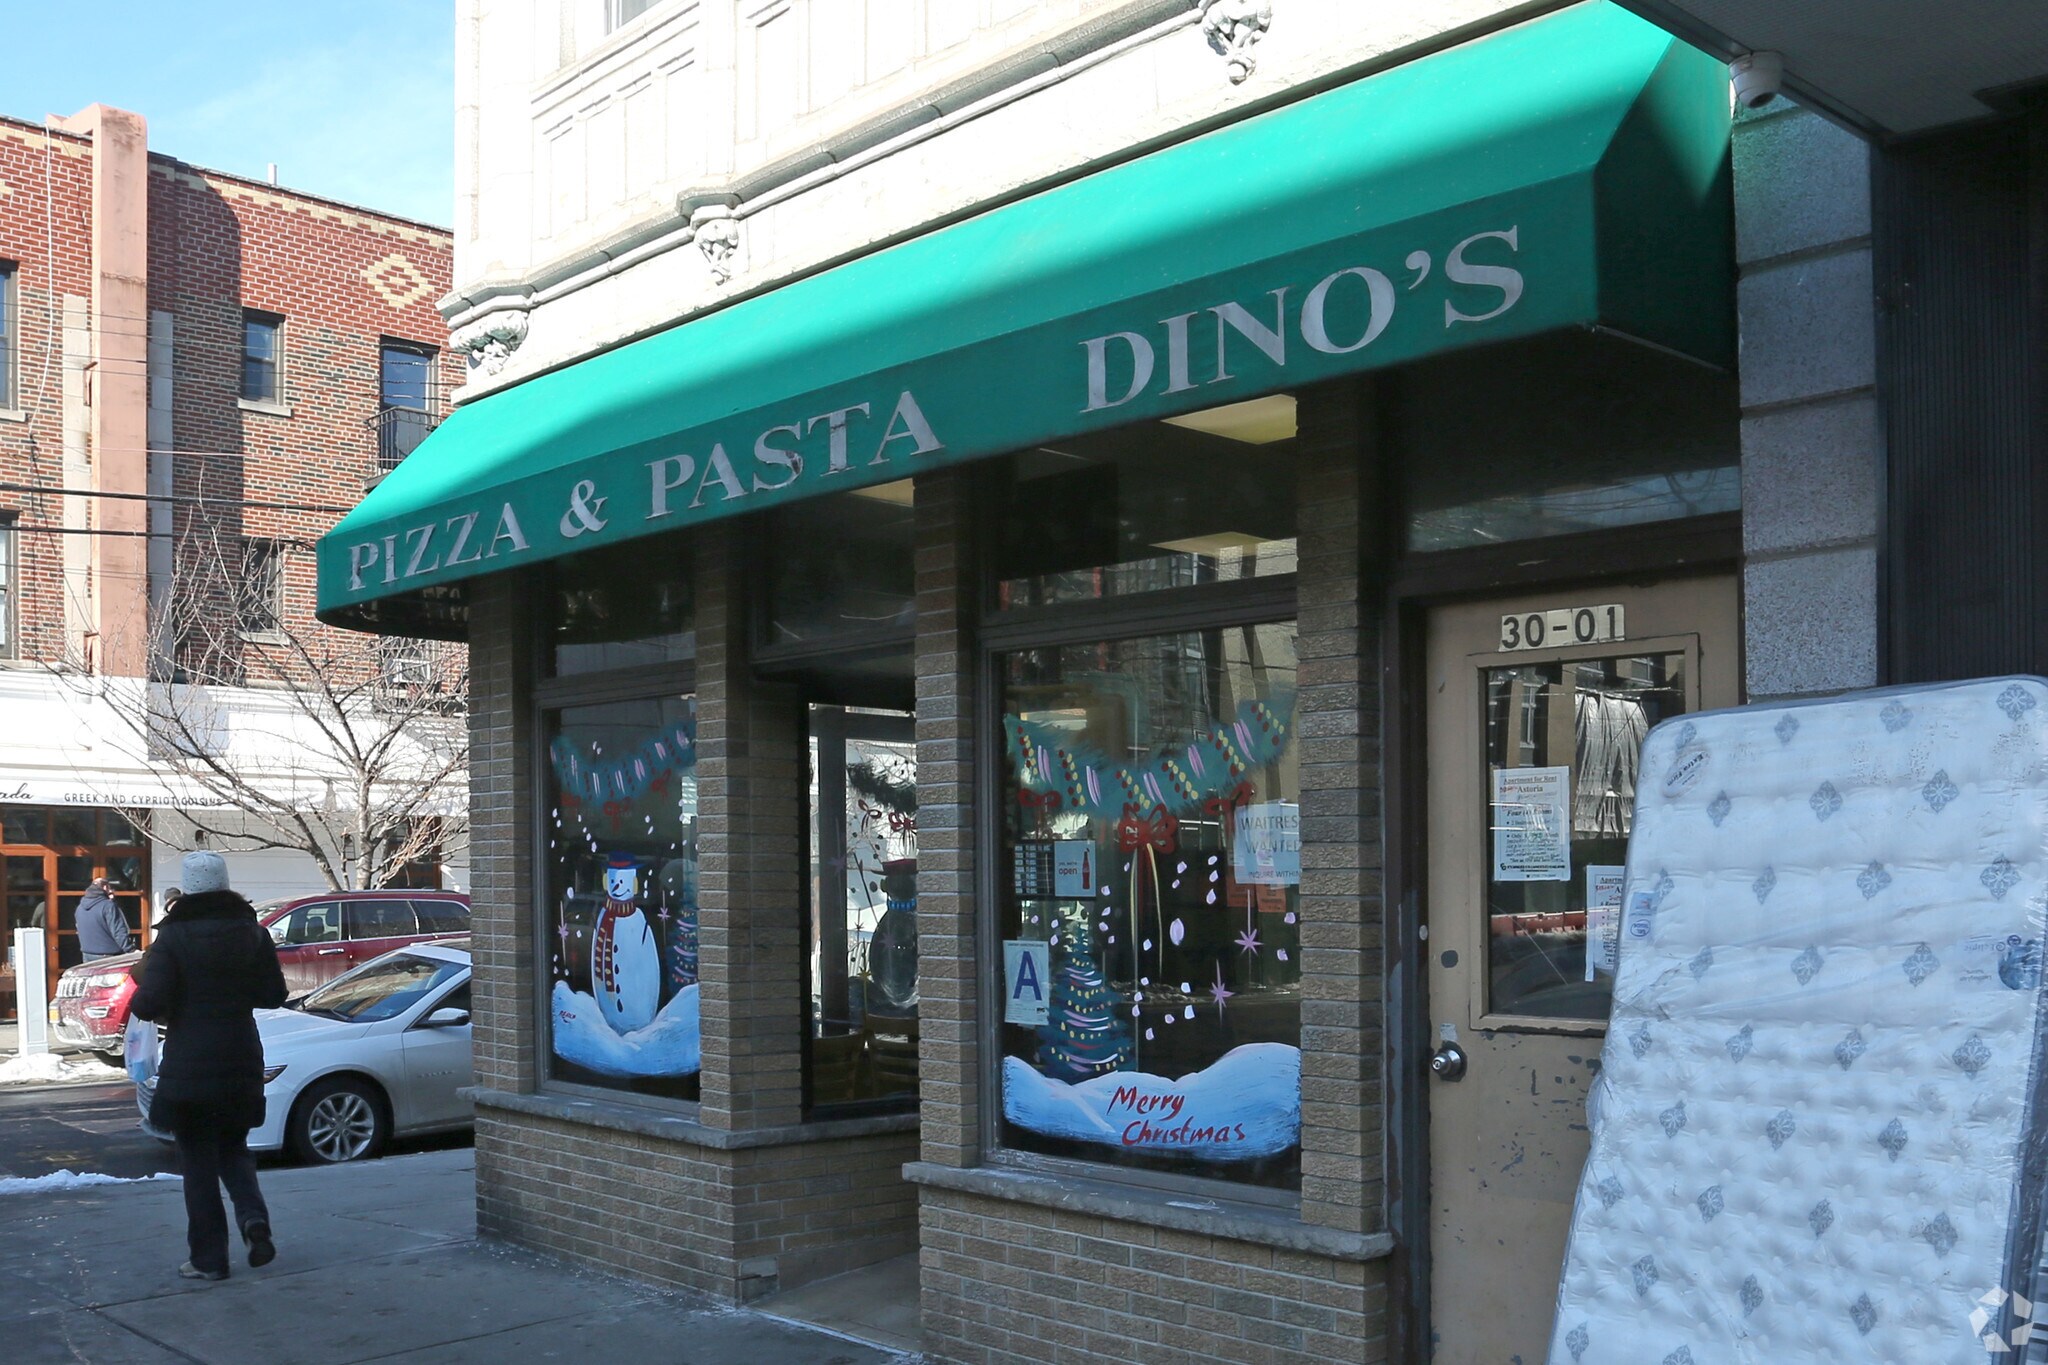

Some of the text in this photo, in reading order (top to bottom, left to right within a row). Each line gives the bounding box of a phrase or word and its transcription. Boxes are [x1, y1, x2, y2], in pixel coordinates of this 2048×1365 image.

[1079, 225, 1524, 413] DINO'S
[348, 390, 946, 591] PIZZA & PASTA
[1501, 606, 1616, 649] 30-01
[64, 793, 99, 803] GREEK
[104, 795, 126, 804] AND
[131, 795, 175, 805] CYPRIOT
[1518, 785, 1544, 793] Astoria
[1241, 815, 1298, 830] WAITRES
[1058, 868, 1078, 876] open
[1013, 951, 1042, 1001] A
[1106, 1085, 1185, 1122] Merry
[1121, 1115, 1246, 1146] Christmas
